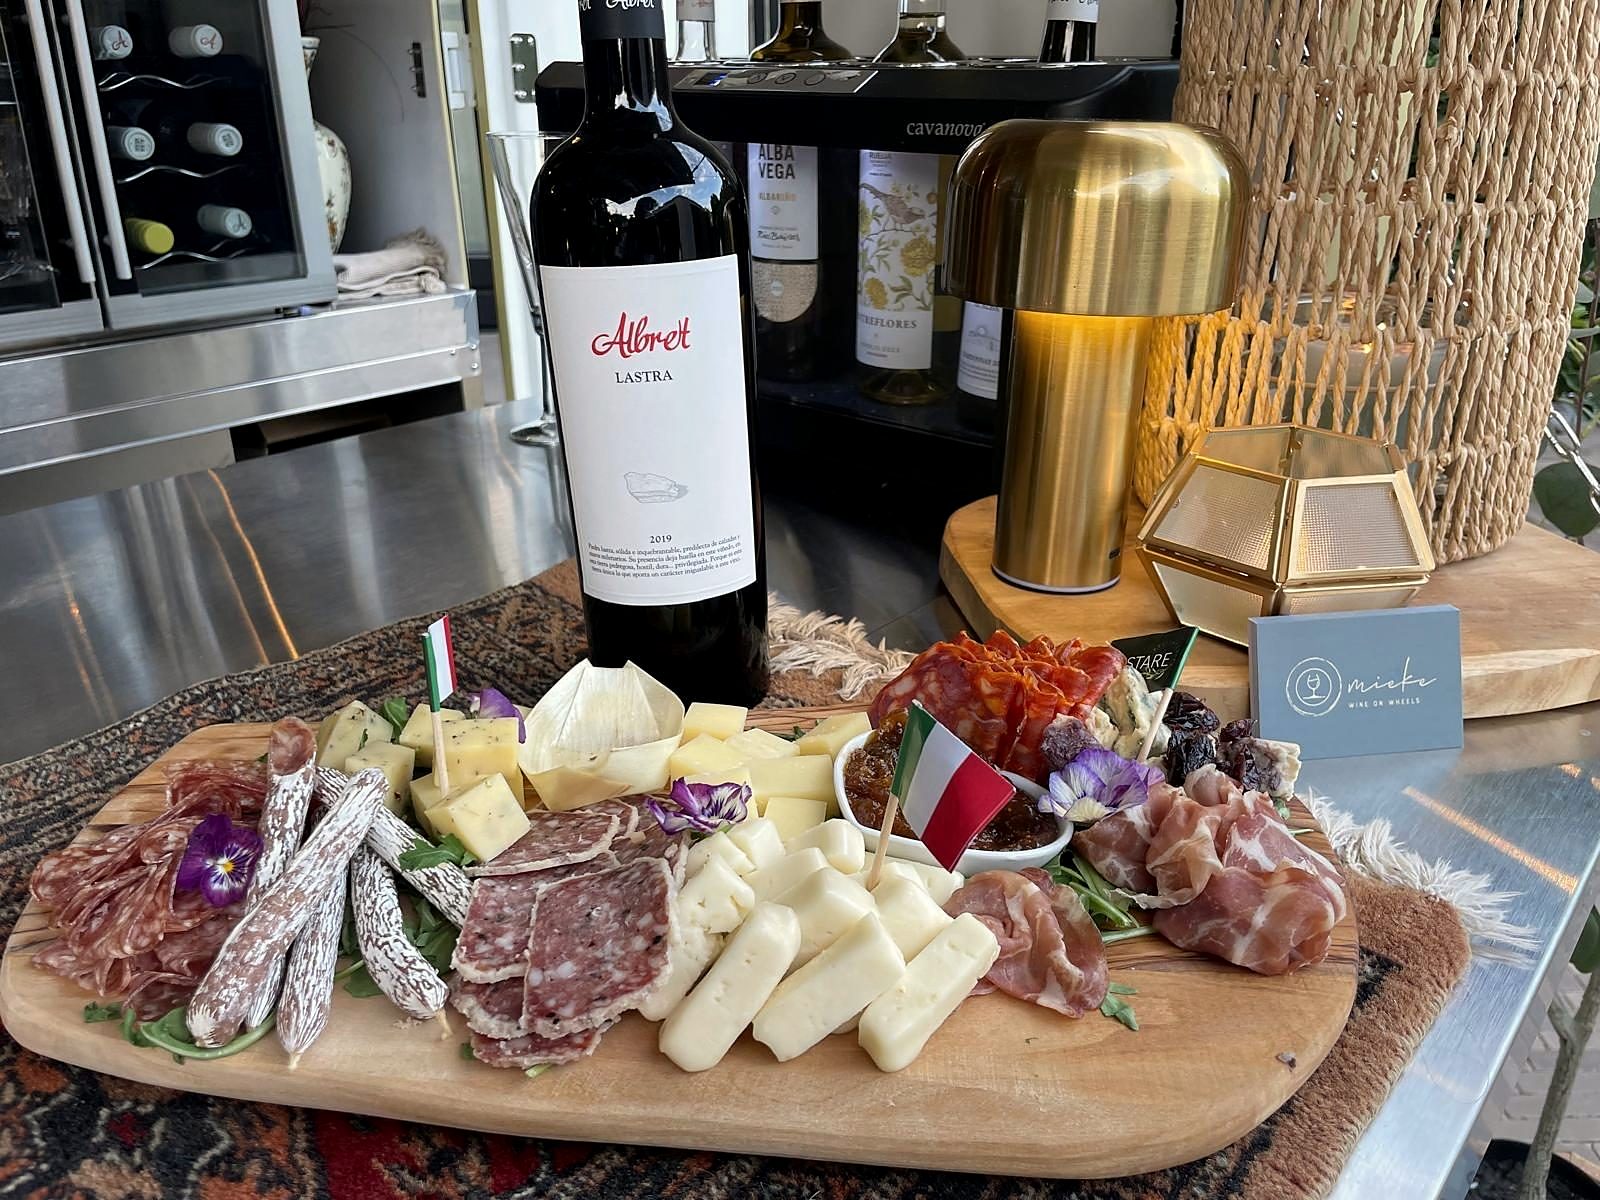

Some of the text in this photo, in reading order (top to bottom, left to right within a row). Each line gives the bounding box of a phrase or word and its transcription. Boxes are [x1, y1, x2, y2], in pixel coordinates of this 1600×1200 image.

[906, 121, 984, 137] cavanova
[759, 143, 795, 161] ALBA
[759, 162, 796, 180] VEGA
[591, 311, 691, 359] Albret
[615, 369, 673, 384] LASTRA
[650, 535, 672, 544] 2019
[711, 539, 718, 547] de
[637, 556, 664, 564] presencia
[678, 552, 697, 560] huella
[1127, 652, 1173, 670] STARE
[1347, 656, 1437, 694] mieke
[1348, 699, 1369, 708] WINE
[1388, 696, 1421, 706] WHEELS
